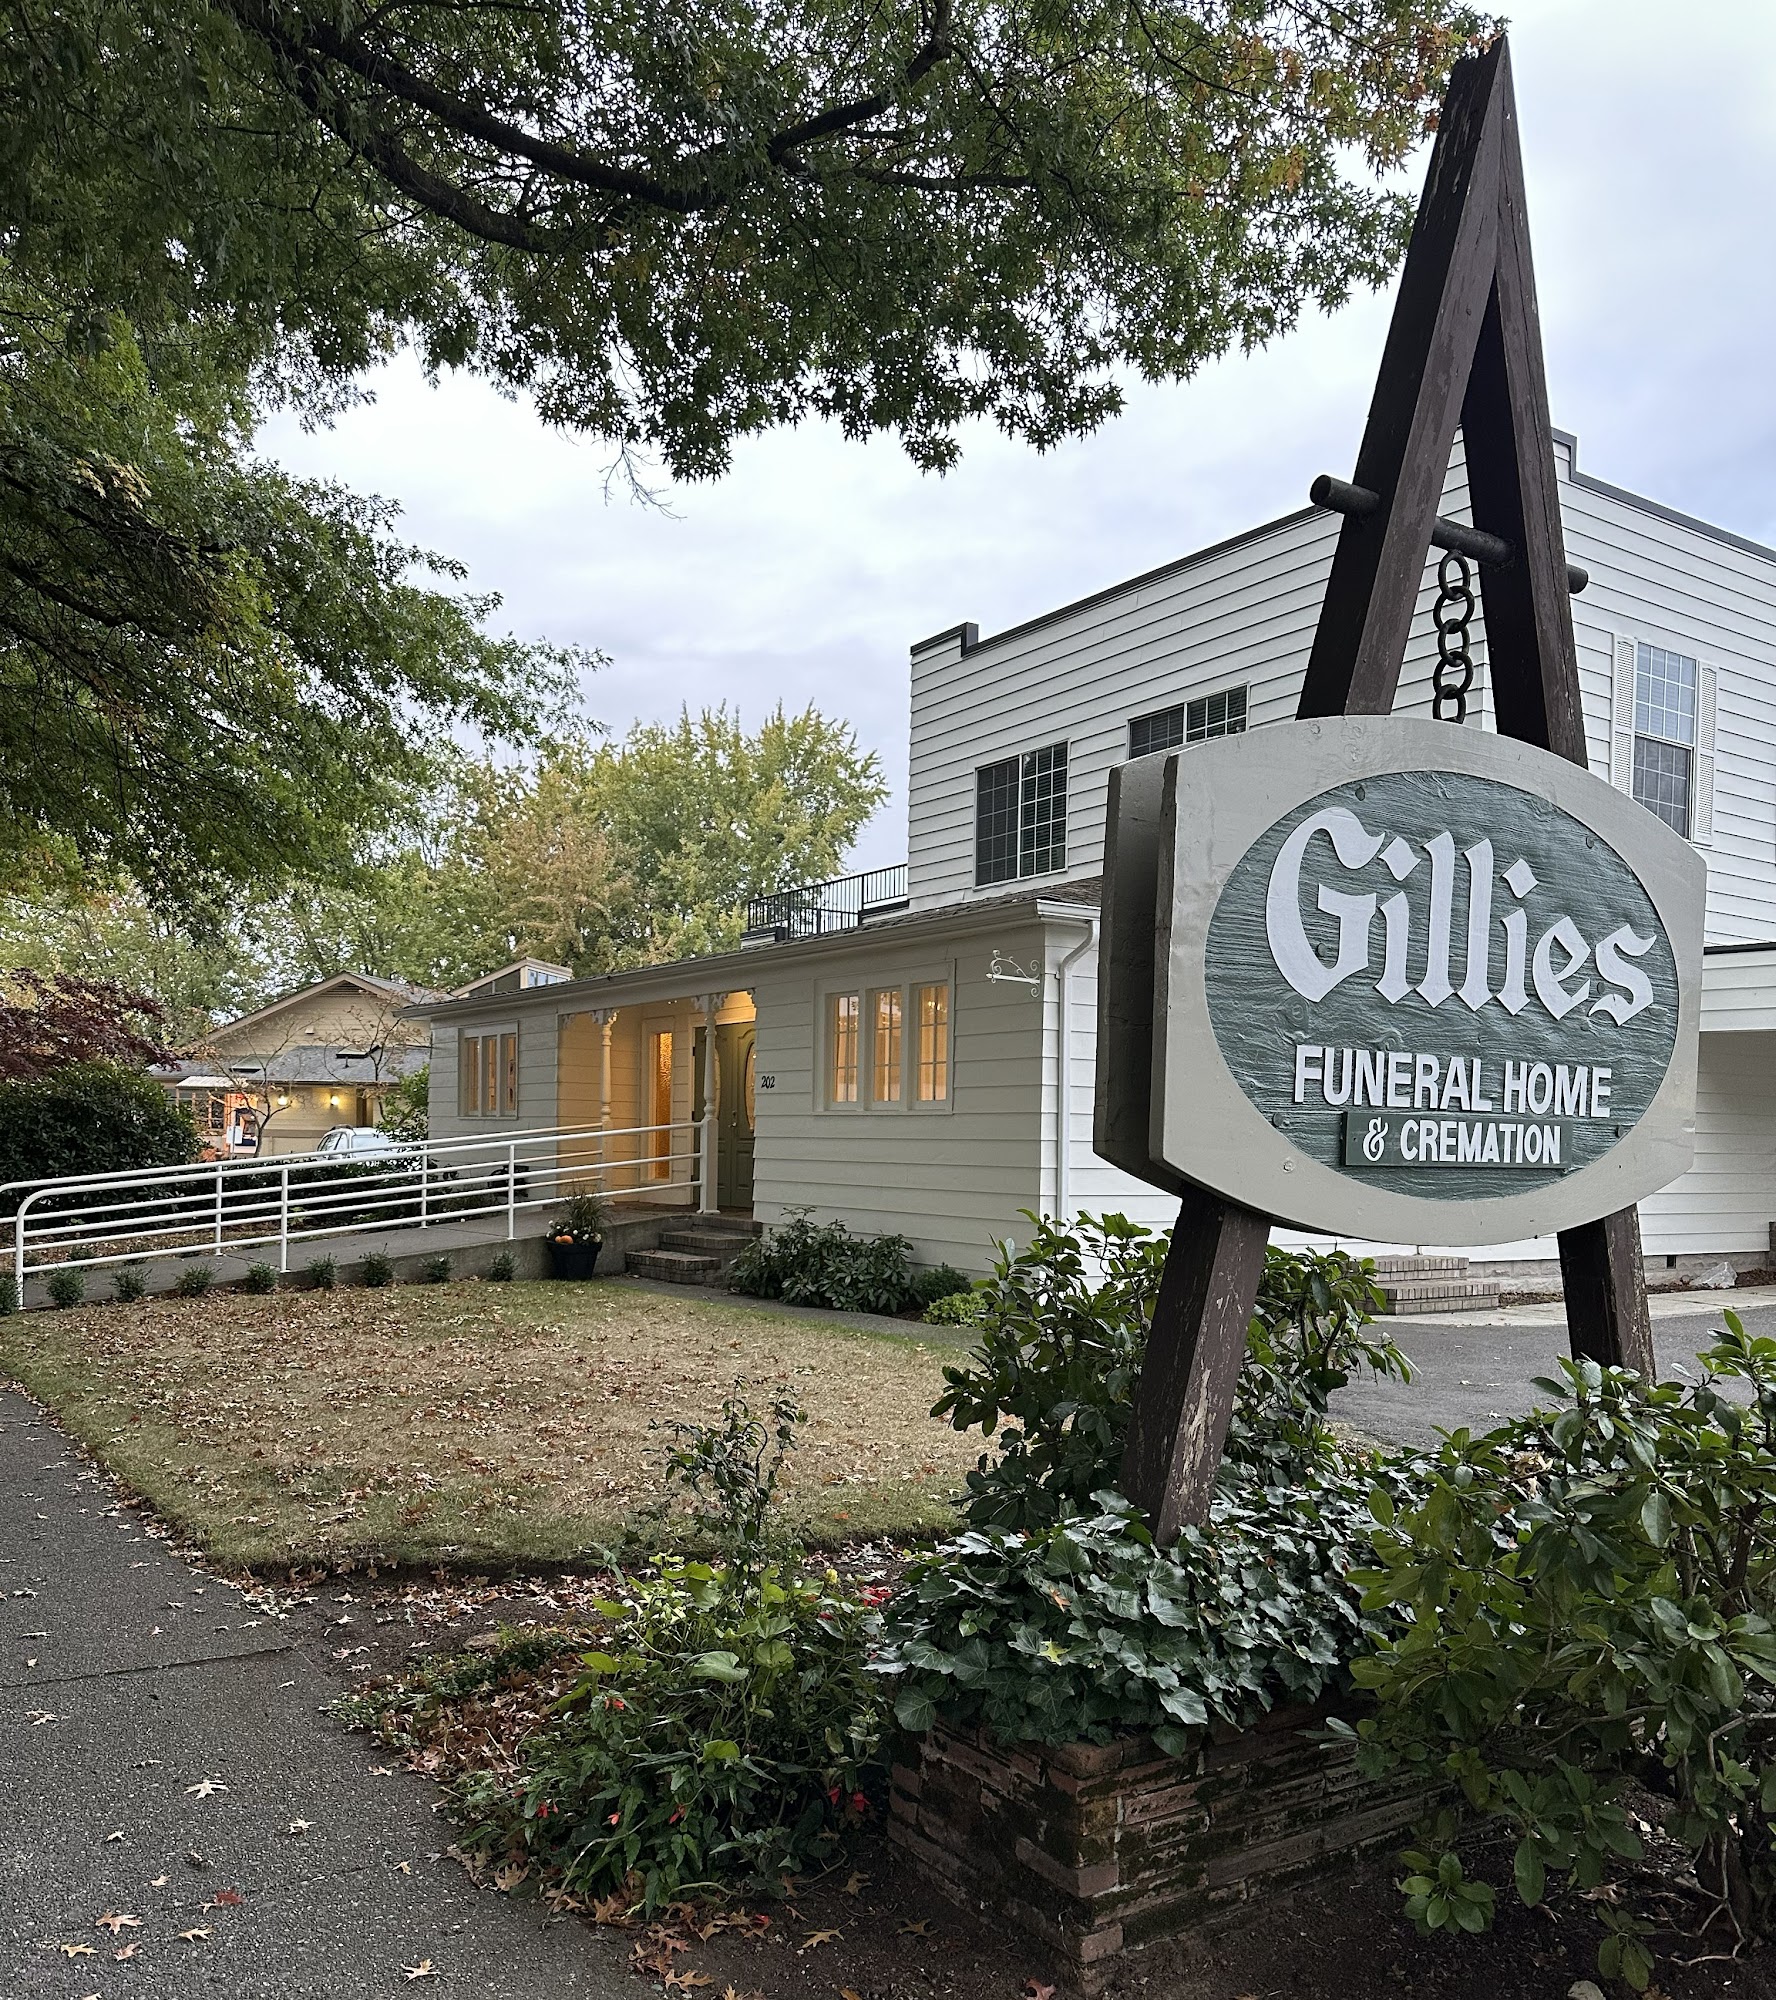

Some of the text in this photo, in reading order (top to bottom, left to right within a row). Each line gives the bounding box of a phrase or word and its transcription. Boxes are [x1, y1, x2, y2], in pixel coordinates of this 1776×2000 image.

[1265, 807, 1657, 1026] Gillies
[761, 1075, 775, 1089] 202
[1294, 1045, 1612, 1118] FUNERAL HOME
[1362, 1117, 1562, 1164] & CREMATION
